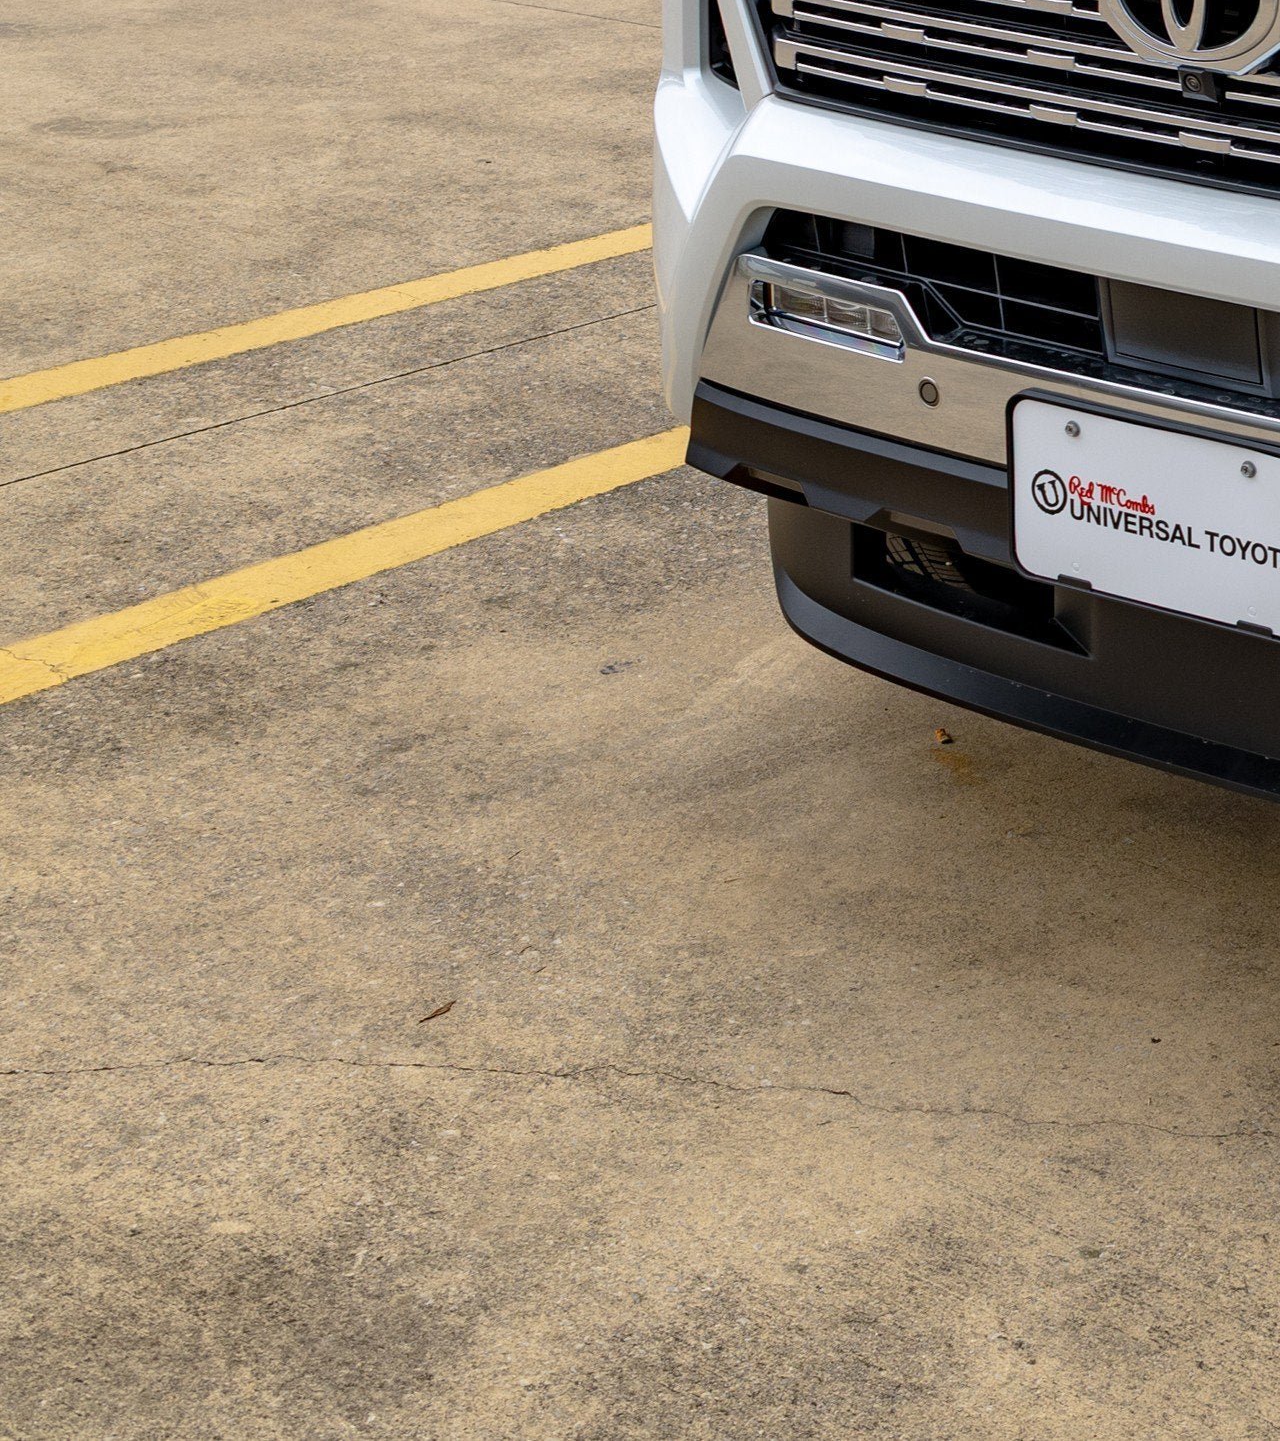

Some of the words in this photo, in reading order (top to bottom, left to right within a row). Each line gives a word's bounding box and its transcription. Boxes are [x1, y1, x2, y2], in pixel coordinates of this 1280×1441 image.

[1069, 476, 1095, 506] Red
[1096, 482, 1155, 515] McCombs
[1069, 498, 1201, 549] UNIVERSAL
